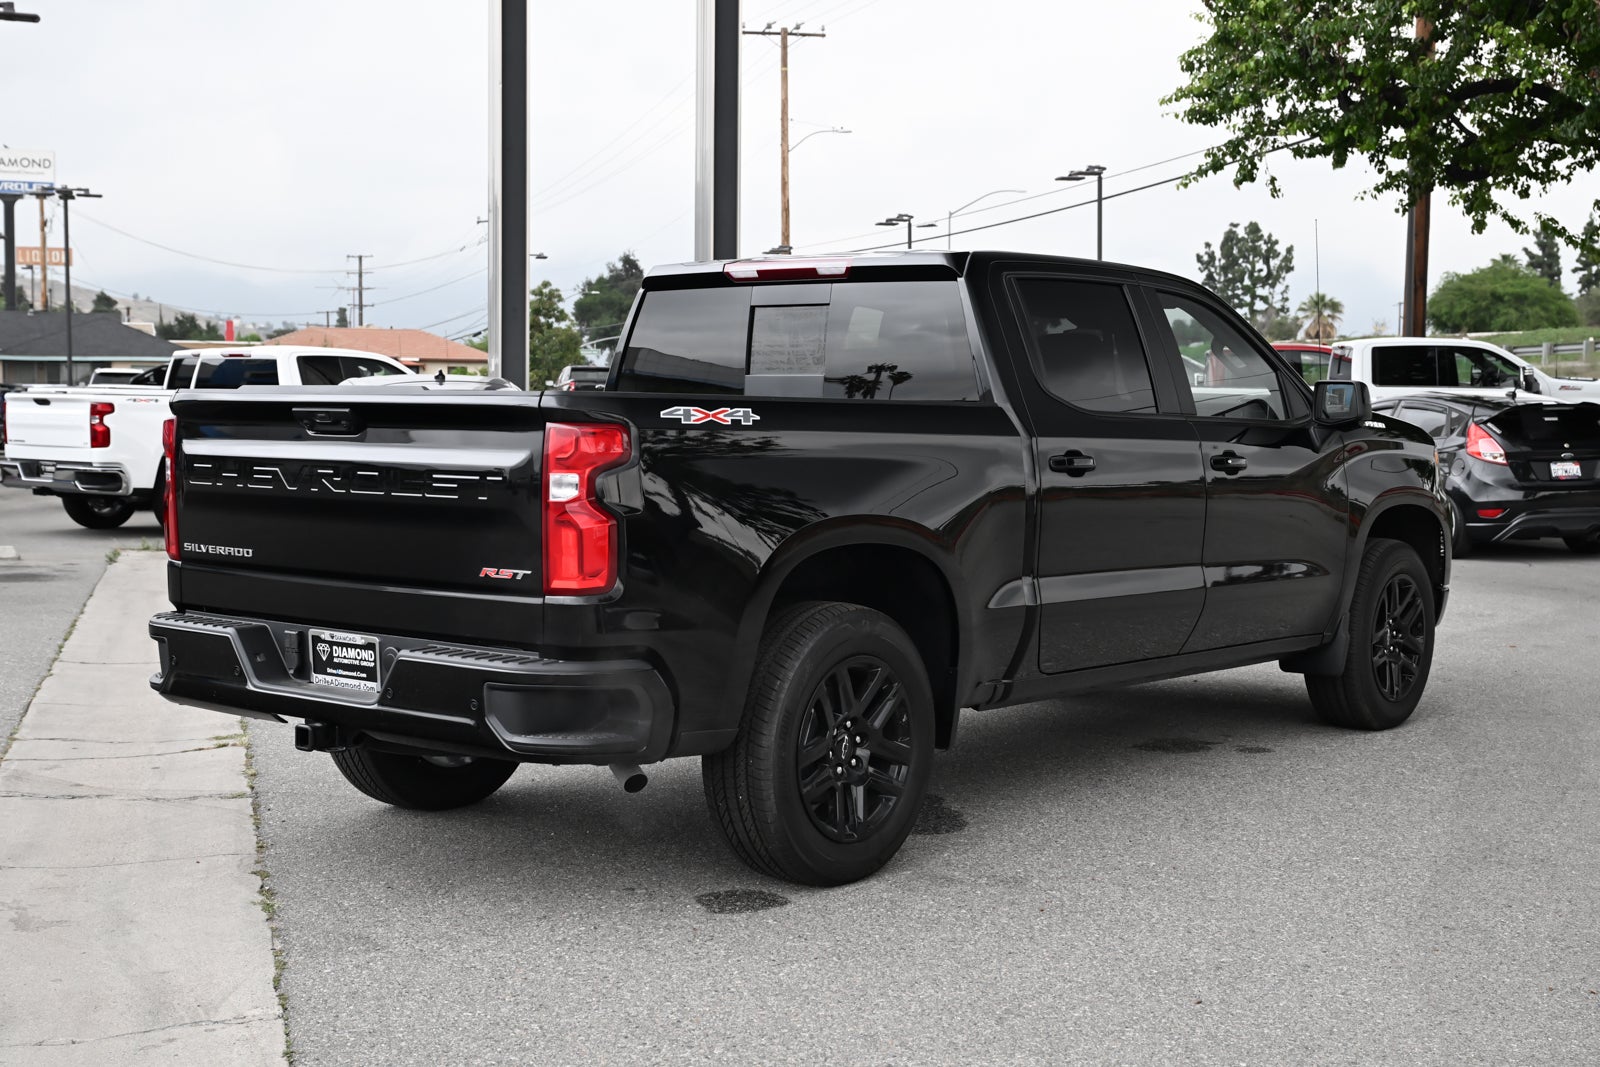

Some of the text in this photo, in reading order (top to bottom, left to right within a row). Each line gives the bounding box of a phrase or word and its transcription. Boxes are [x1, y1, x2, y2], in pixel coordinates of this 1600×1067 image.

[18, 250, 68, 263] LIQO
[183, 542, 253, 558] SILVERADO
[479, 567, 532, 580] RST
[333, 646, 374, 660] DIAMOND
